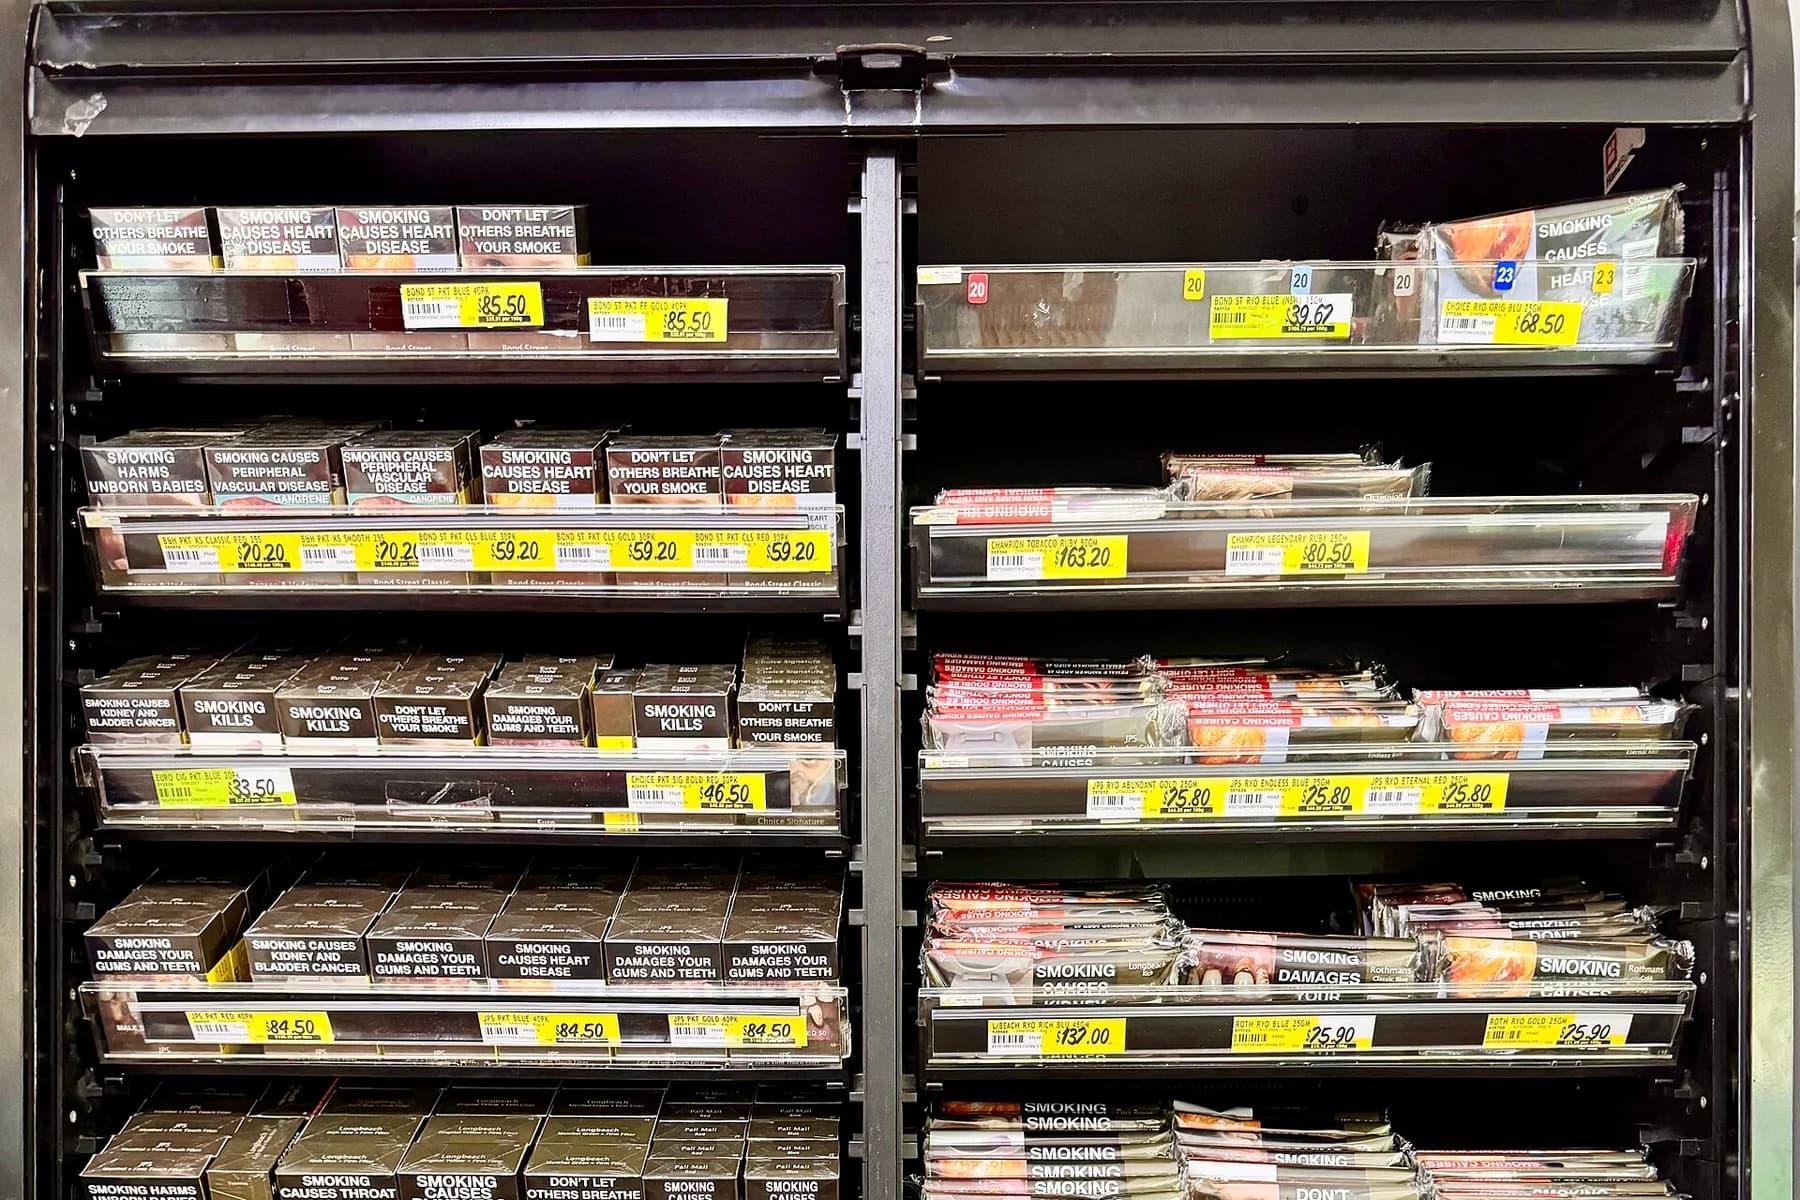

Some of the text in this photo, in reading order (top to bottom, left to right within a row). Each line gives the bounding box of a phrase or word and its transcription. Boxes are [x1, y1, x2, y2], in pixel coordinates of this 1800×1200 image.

[240, 211, 311, 224] SMOKING
[483, 210, 549, 222] DON'T LET
[223, 225, 334, 239] CAUSES HEART
[461, 225, 574, 238] OTHERS BREATHE
[1538, 215, 1612, 239] SMOKING
[248, 241, 312, 254] DISEASE
[475, 241, 561, 253] YOUR SMOKE
[1293, 274, 1308, 288] 20
[1396, 275, 1410, 289] 20
[1498, 268, 1513, 283] 23
[970, 281, 985, 297] 20
[1188, 278, 1201, 292] 20
[478, 295, 526, 316] $85.50
[664, 311, 711, 332] $85.50
[1514, 312, 1564, 334] $68.50
[107, 451, 175, 464] SMOKING
[215, 452, 320, 463] SMOKING CAUSES
[118, 467, 170, 478] HARMS
[232, 467, 306, 478] PERIPHERAL
[89, 480, 204, 493] UNBORN BABIES
[214, 481, 329, 492] VASCULAR DISEASE
[491, 541, 539, 561] $59.20
[629, 541, 677, 561] $59.20
[767, 541, 815, 561] $59.20
[991, 539, 1056, 549] CHAMPION TOBACCO
[238, 541, 285, 563] $70.20
[1055, 547, 1109, 568] $163.20
[1303, 543, 1352, 562] $80.50
[194, 700, 266, 715] SMOKING
[645, 704, 716, 718] SMOKING
[212, 713, 253, 727] KILLS
[660, 718, 703, 731] KILLS
[700, 784, 749, 803] $46.50
[114, 938, 171, 949] SMOKING
[97, 950, 193, 960] DAMAGES YOUR
[96, 961, 200, 971] GUMS AND TEETH
[1036, 964, 1116, 978] SMOKING
[1540, 958, 1621, 977] SMOKING
[1628, 964, 1664, 974] Rothmans
[266, 1019, 314, 1035] $84.50
[556, 1023, 603, 1039] $84.50
[743, 1023, 791, 1039] $84.50
[1560, 1023, 1610, 1041] $75.90
[1055, 1028, 1109, 1046] $137.00
[1306, 1027, 1355, 1044] $75.90
[302, 1176, 371, 1187] SMOKING
[280, 1188, 396, 1199] CAUSES THROAT
